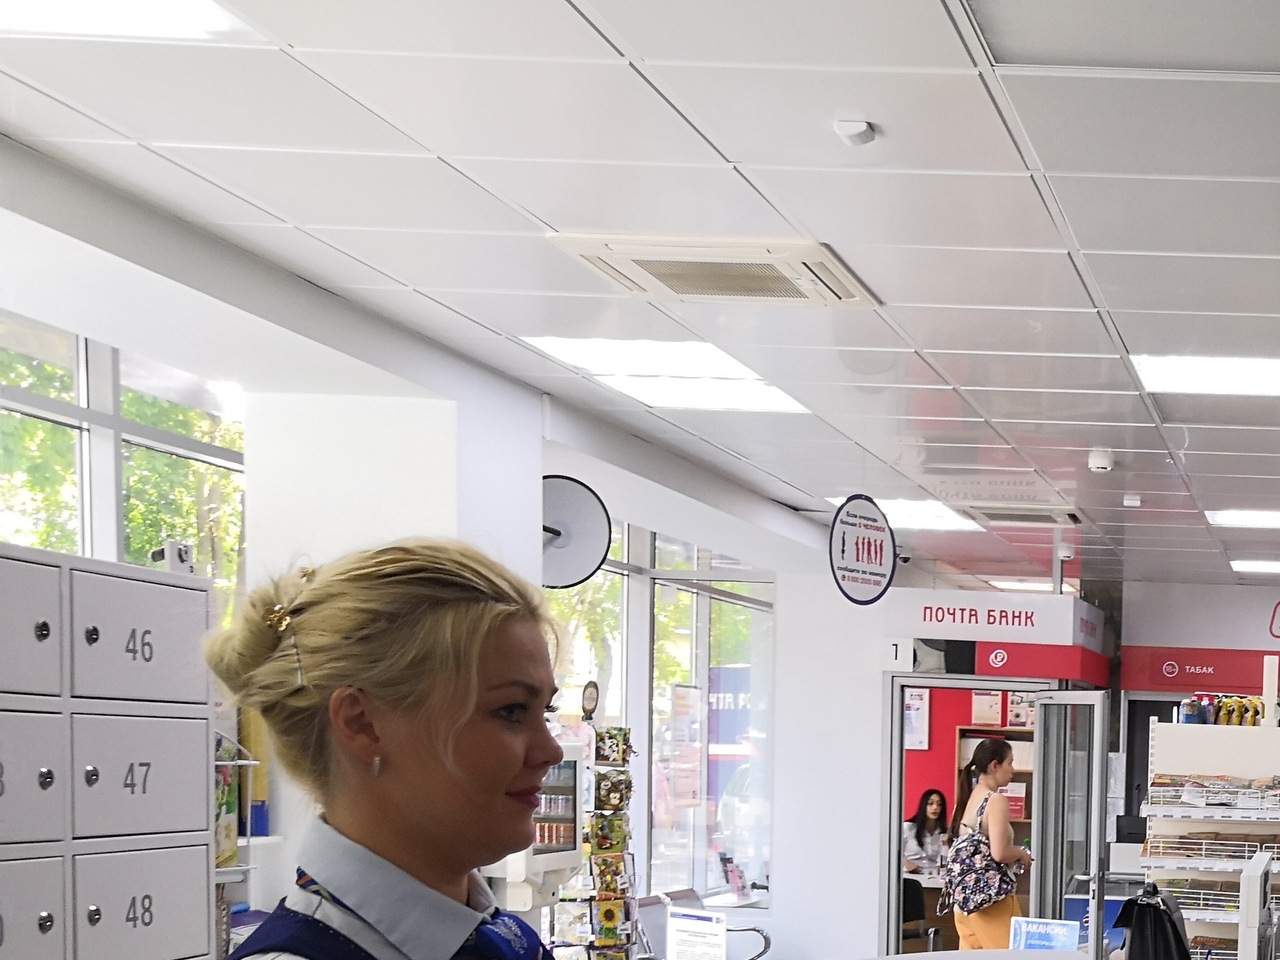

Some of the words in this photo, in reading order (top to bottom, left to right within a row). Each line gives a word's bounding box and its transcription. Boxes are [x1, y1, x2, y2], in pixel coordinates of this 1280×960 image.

[923, 606, 979, 625] ПОЧТА
[986, 609, 1035, 628] БАНК
[125, 628, 154, 663] 46
[892, 643, 898, 661] 1
[1185, 666, 1215, 674] ТАБАК
[123, 762, 152, 795] 47
[125, 894, 153, 929] 48
